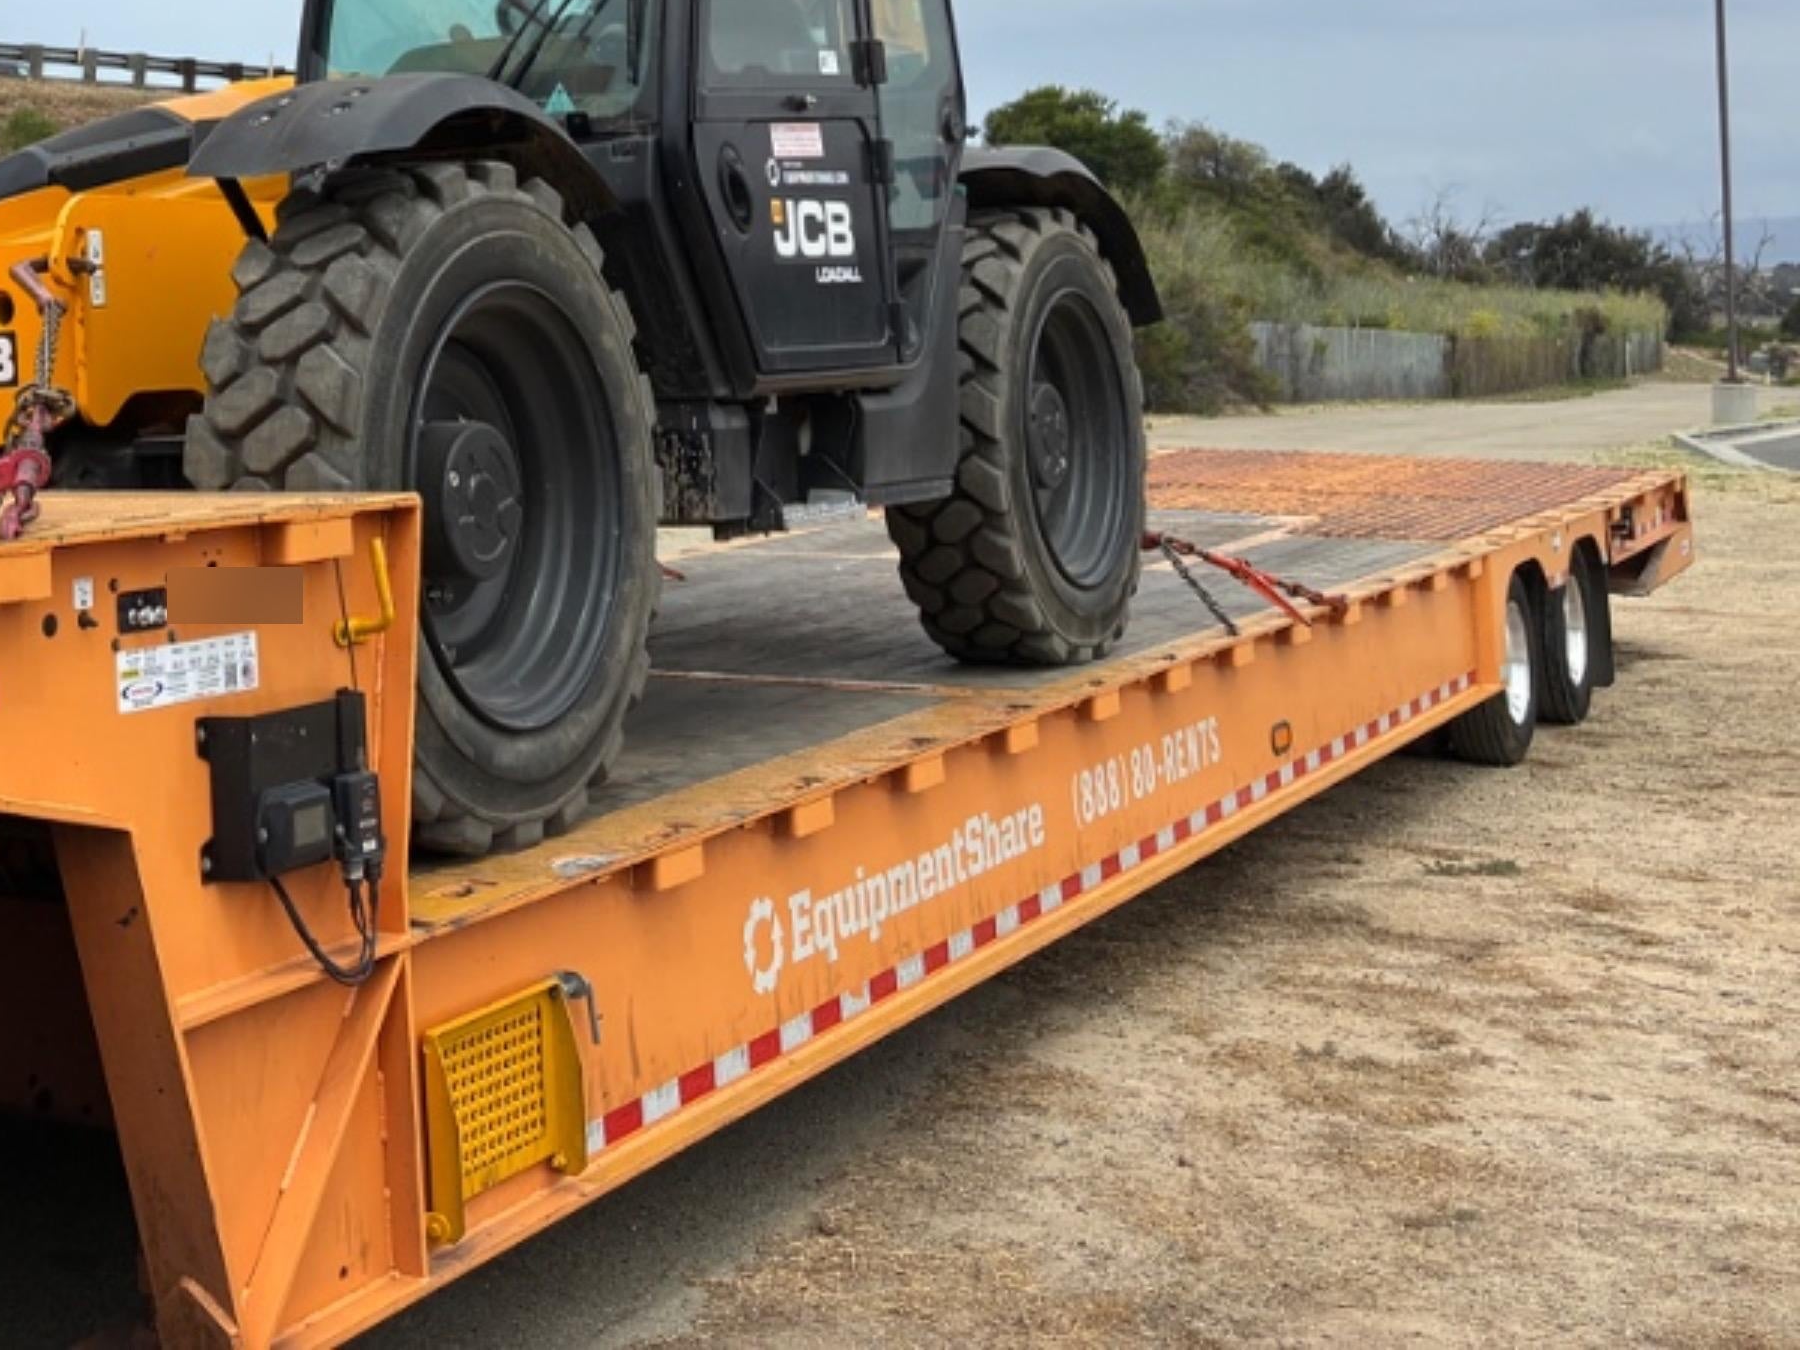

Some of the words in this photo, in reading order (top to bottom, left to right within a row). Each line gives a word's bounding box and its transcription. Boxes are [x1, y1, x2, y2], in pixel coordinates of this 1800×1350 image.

[774, 198, 856, 257] JCB
[788, 802, 1046, 964] EquipmentShare
[1073, 757, 1130, 826] (888)
[1130, 715, 1221, 800] 80-RENTS
